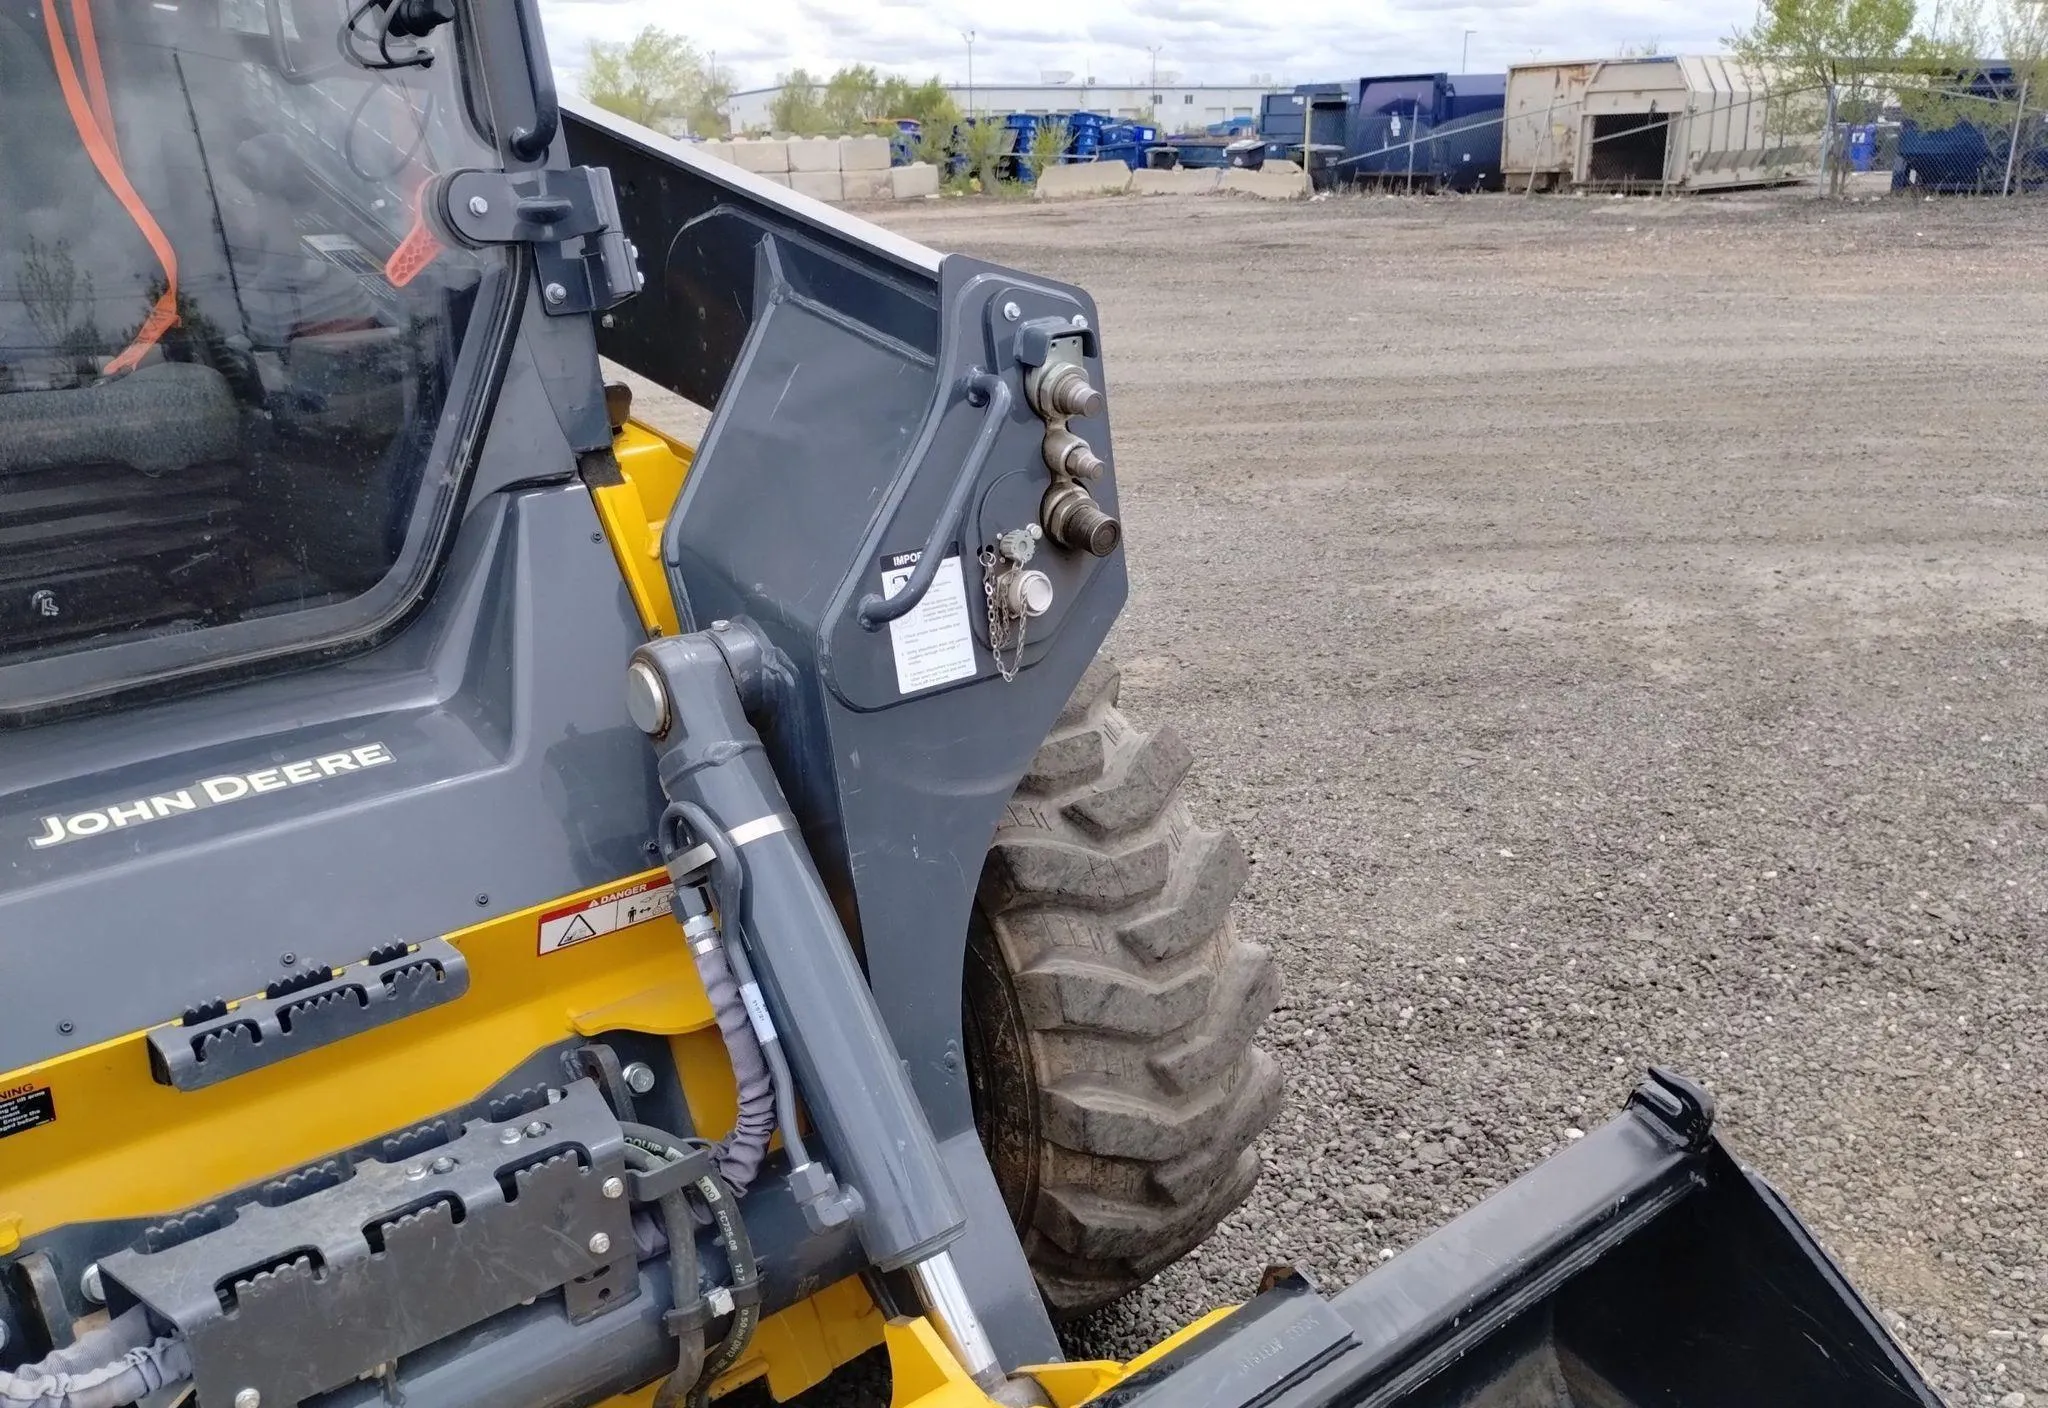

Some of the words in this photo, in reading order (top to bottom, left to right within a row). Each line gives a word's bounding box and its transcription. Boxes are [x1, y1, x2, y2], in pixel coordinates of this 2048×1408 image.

[34, 790, 198, 847] JOHN
[200, 743, 392, 804] DEERE
[600, 884, 648, 905] DANGER
